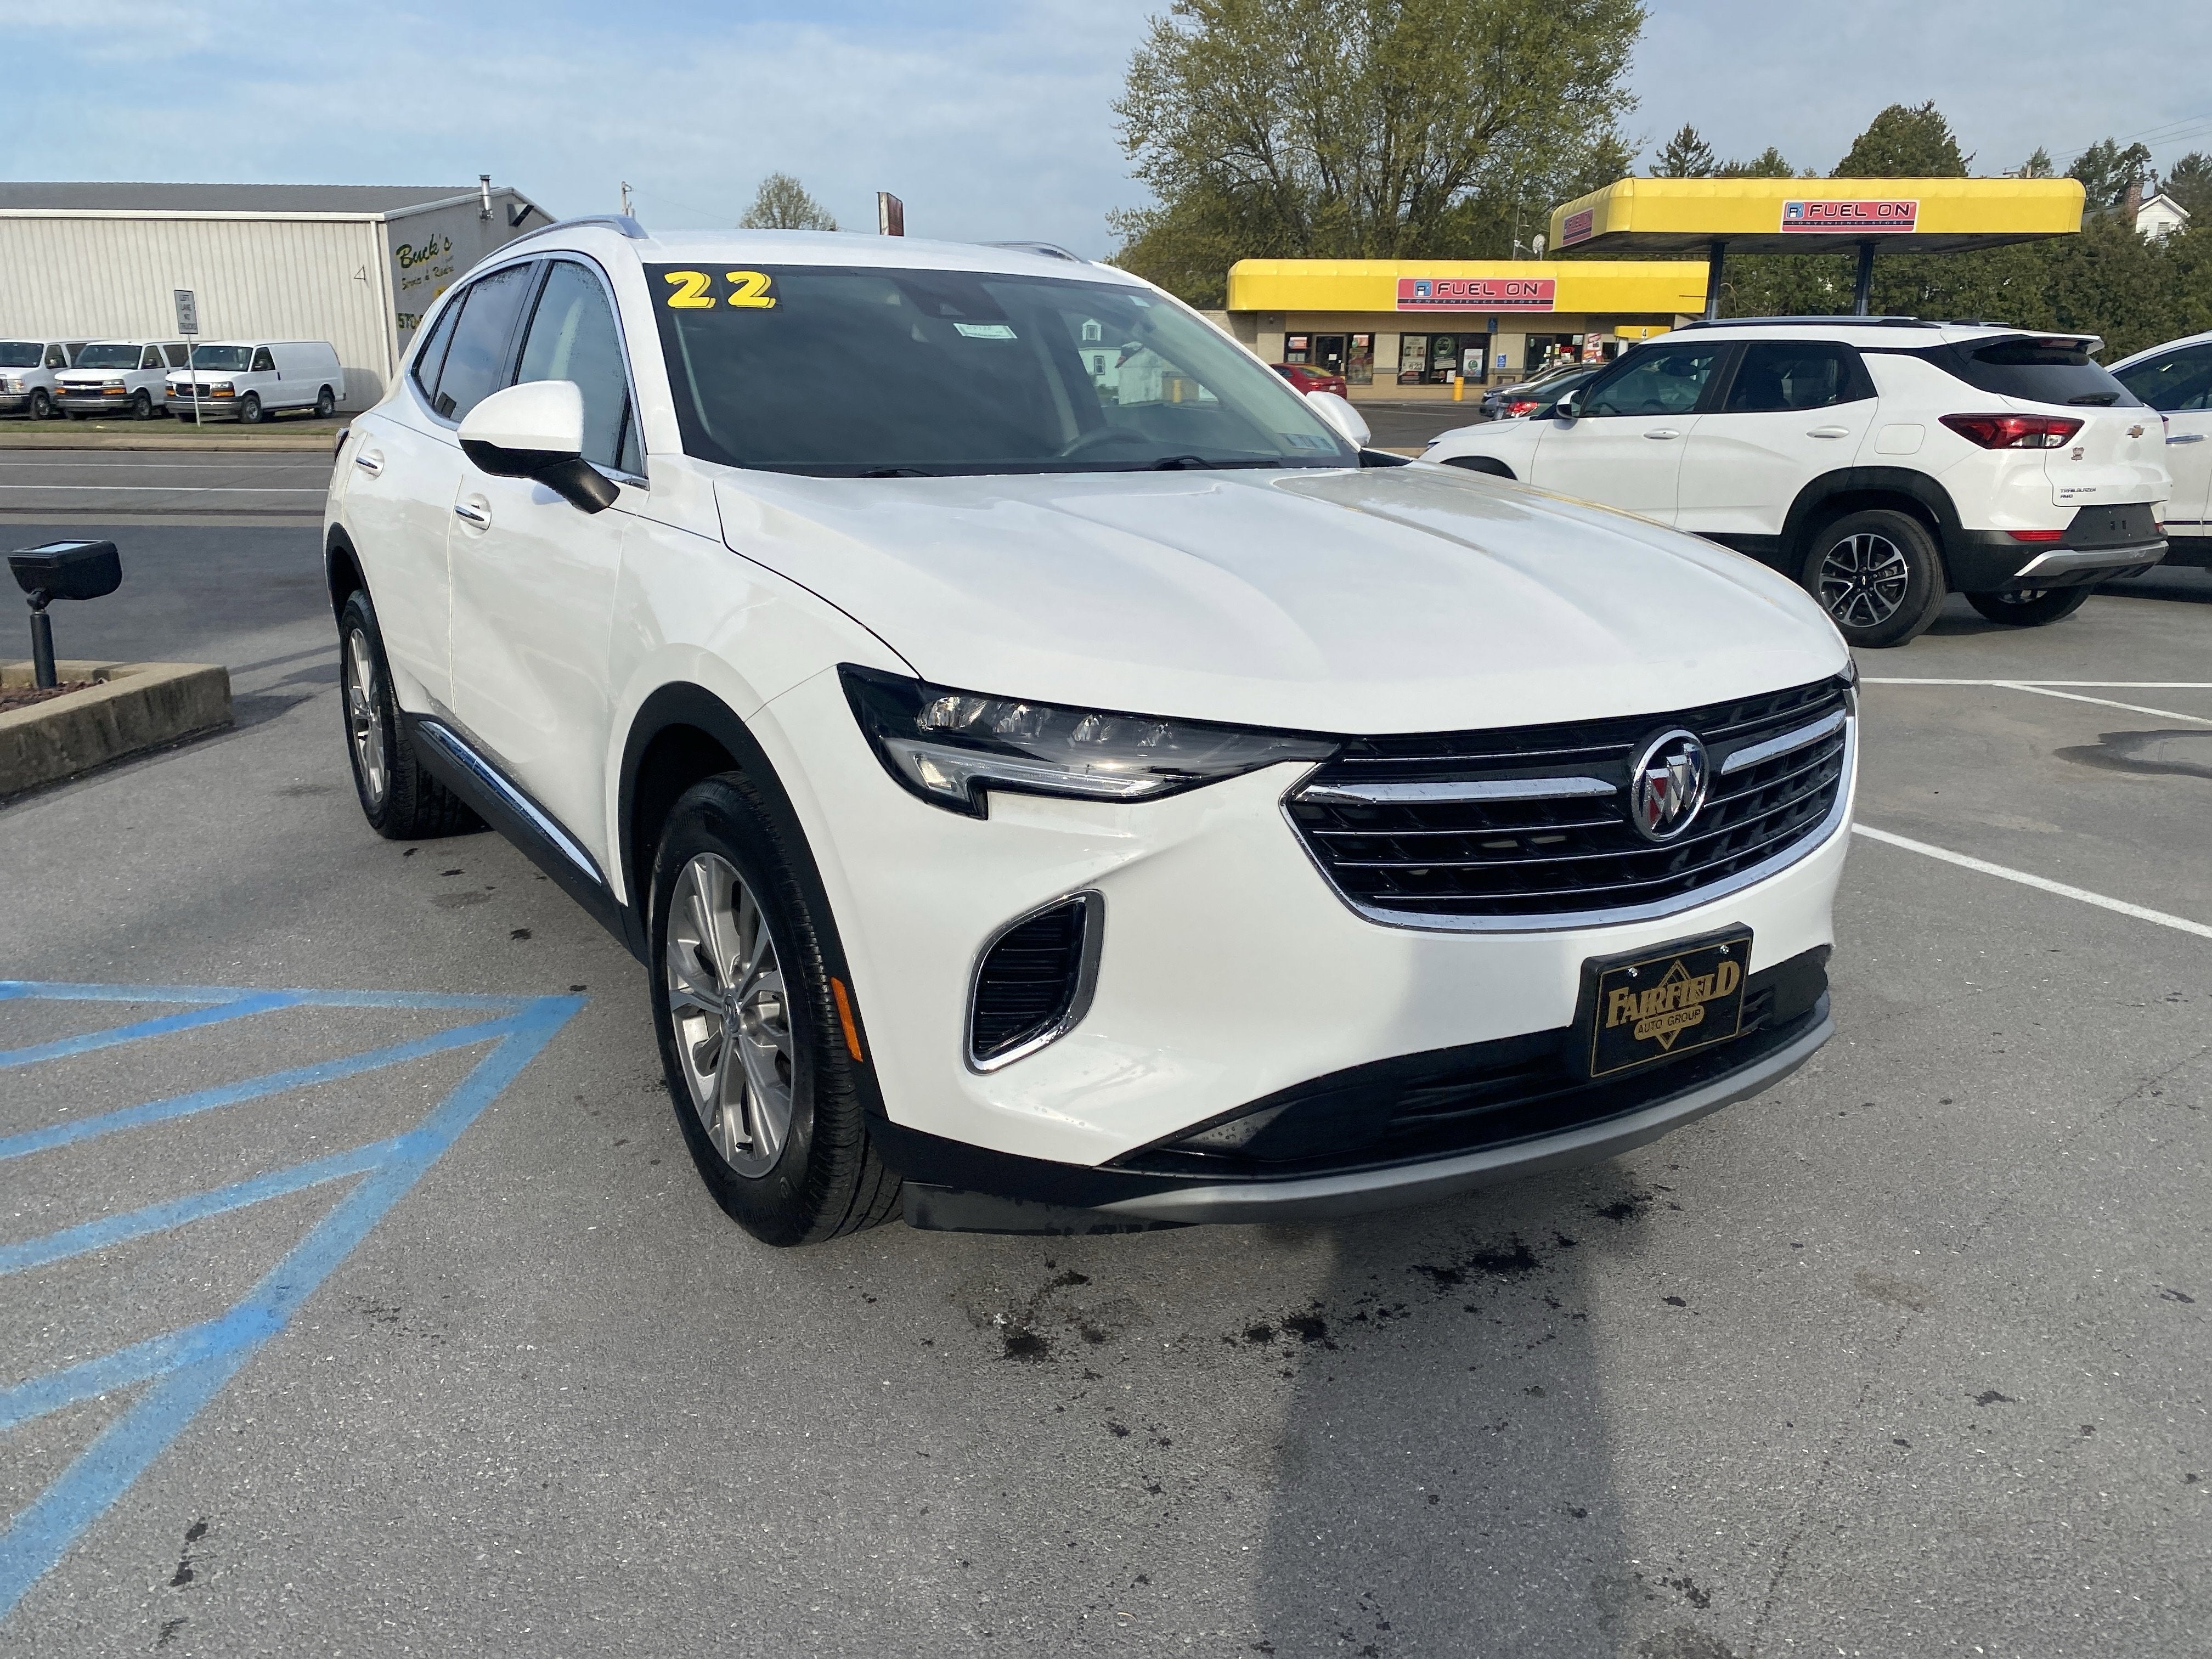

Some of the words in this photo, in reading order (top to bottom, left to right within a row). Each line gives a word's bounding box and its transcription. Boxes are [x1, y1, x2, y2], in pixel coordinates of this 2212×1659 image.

[1809, 204, 1866, 217] FUEL
[1878, 204, 1909, 217] ON
[396, 233, 453, 268] Buck's
[664, 270, 776, 308] 22
[1437, 283, 1495, 295] FUEL
[1506, 283, 1537, 295] ON
[1642, 329, 1647, 337] 4
[1606, 961, 1740, 1028] FAIRFIELD
[1638, 1019, 1663, 1034] AUTO
[1667, 1008, 1701, 1026] GROUP
